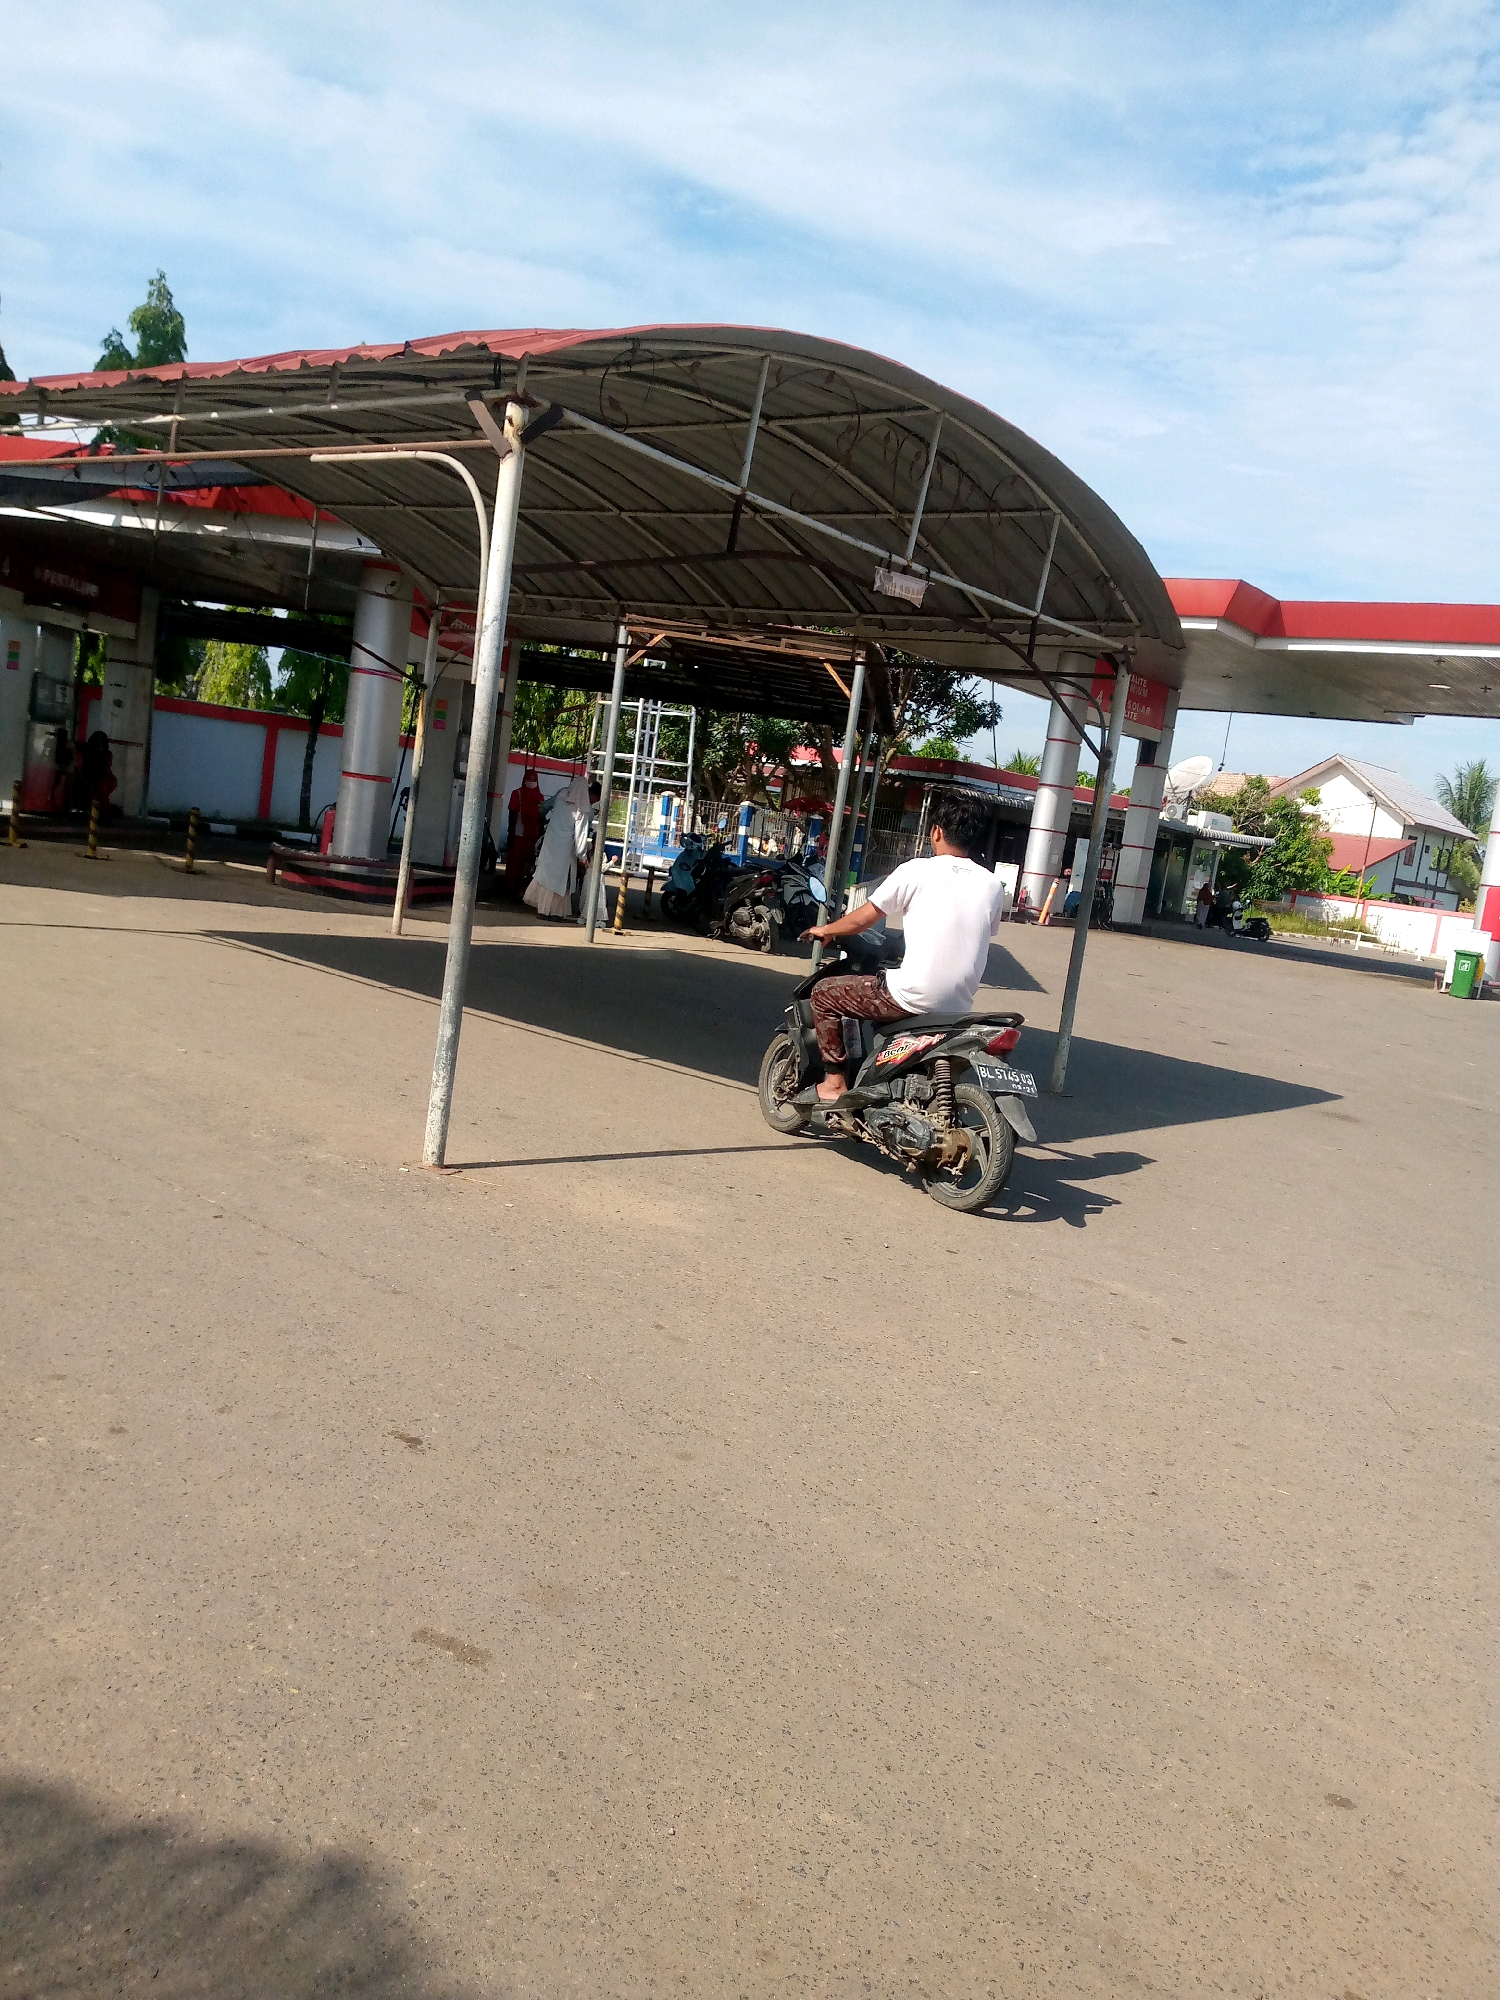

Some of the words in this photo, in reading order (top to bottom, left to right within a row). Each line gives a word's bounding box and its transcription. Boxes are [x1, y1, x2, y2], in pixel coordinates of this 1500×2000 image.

[1127, 700, 1151, 716] SOLAR
[979, 1066, 995, 1078] BL
[995, 1068, 1020, 1083] 5745
